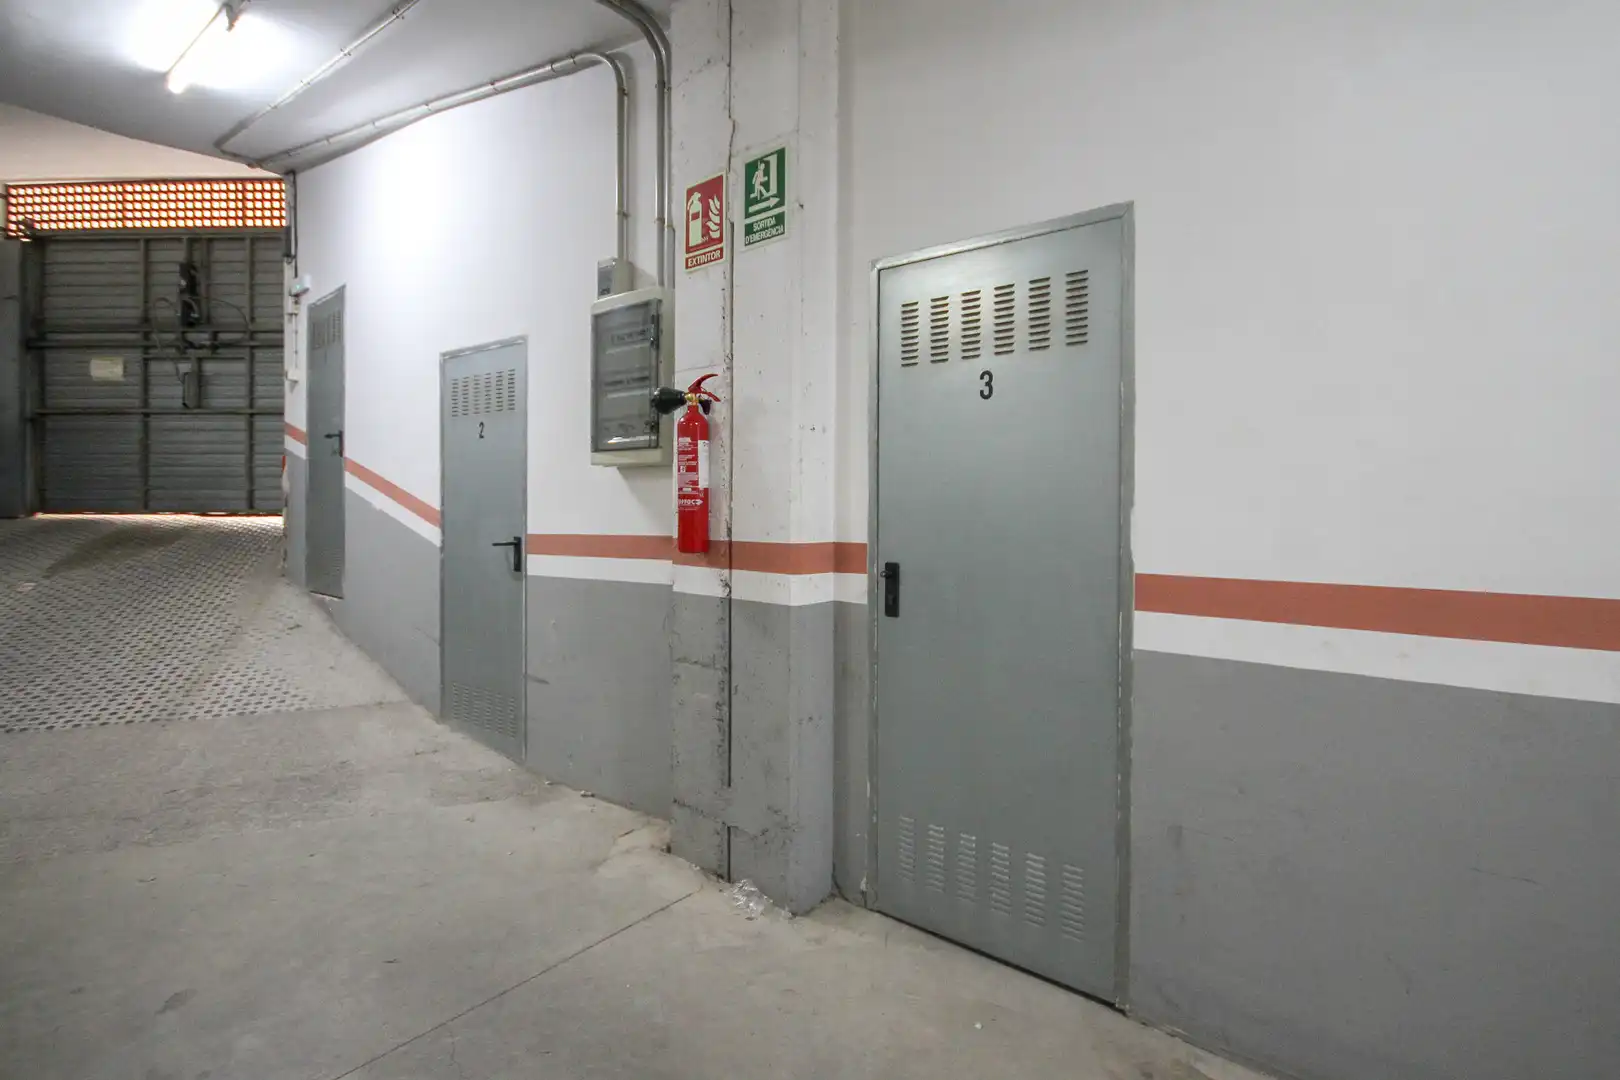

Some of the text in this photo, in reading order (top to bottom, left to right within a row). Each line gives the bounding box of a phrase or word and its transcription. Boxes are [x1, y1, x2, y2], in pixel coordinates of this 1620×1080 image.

[753, 216, 776, 233] SORTIDA
[687, 249, 721, 267] EXTINTOR
[980, 370, 993, 400] 3
[478, 421, 485, 439] 2
